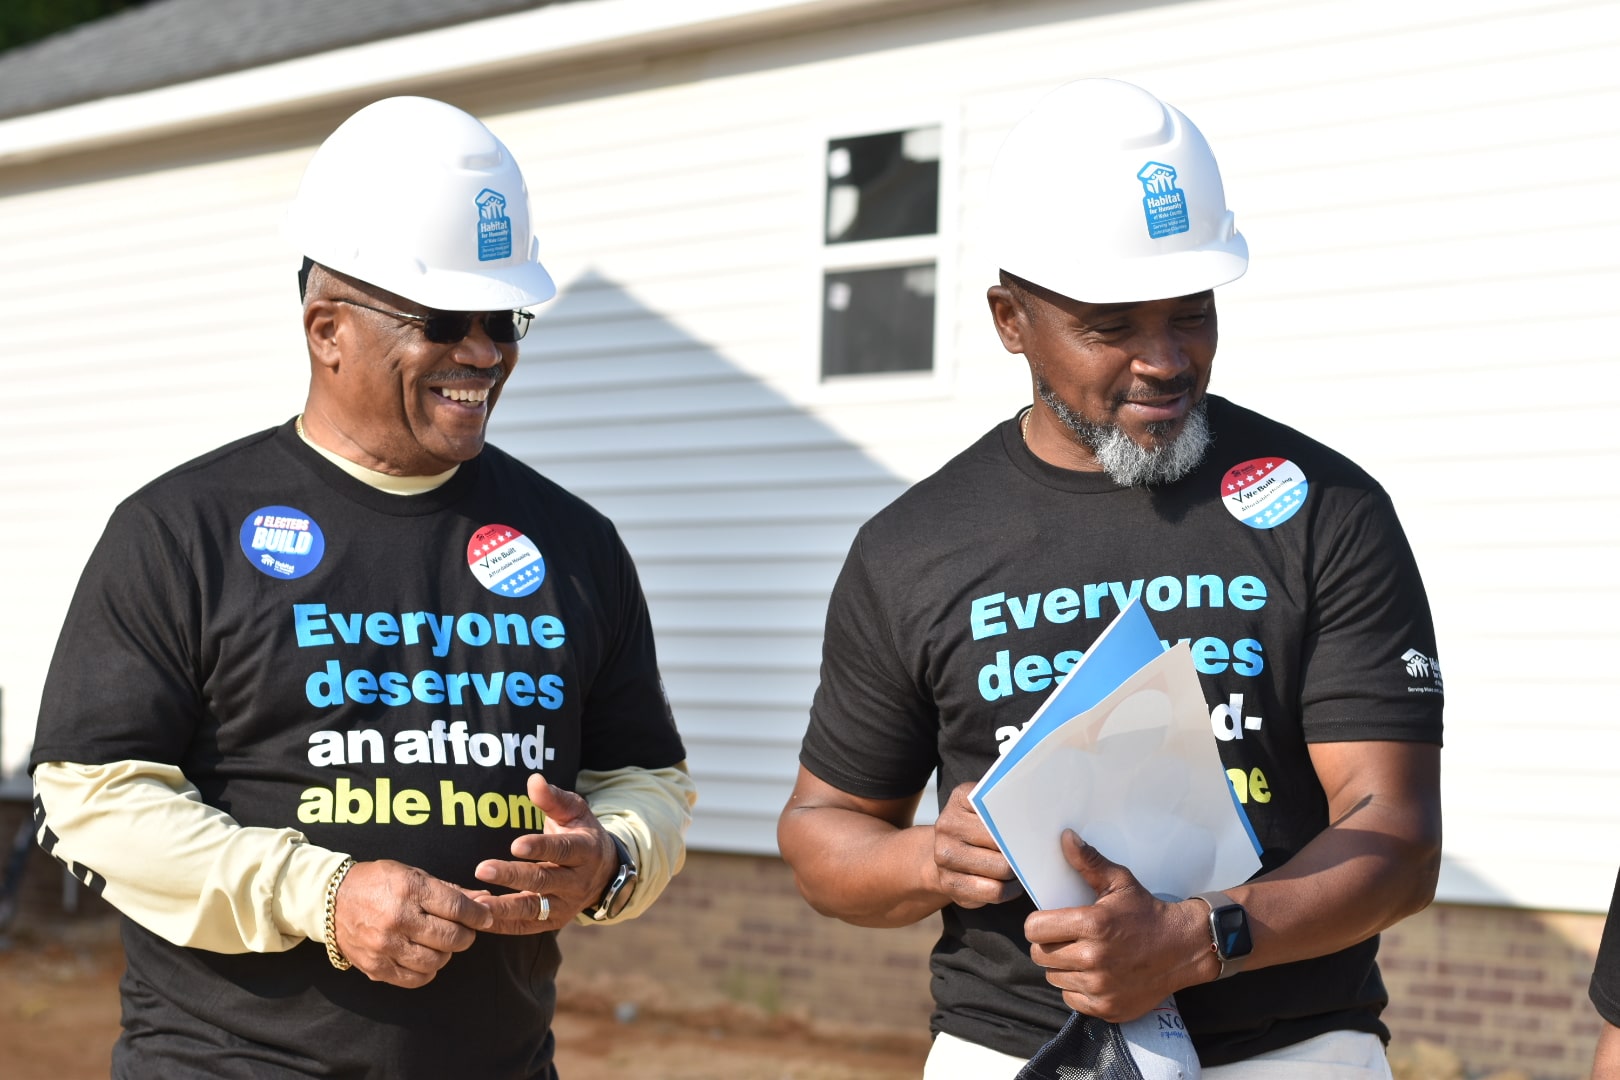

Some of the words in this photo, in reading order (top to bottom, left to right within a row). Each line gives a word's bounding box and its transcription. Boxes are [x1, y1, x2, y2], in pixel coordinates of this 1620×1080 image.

[1147, 193, 1181, 208] Habitat
[481, 220, 508, 232] Habitat
[1244, 490, 1258, 500] We
[1257, 477, 1276, 492] Built
[251, 527, 314, 556] BUILD
[490, 556, 503, 565] We
[500, 547, 516, 560] Built
[970, 574, 1268, 641] Everyone
[292, 603, 566, 657] Everyone
[305, 659, 564, 710] deserves
[978, 636, 1264, 702] deses
[307, 728, 385, 768] an
[393, 719, 556, 771] afford-
[995, 721, 1030, 756] a
[297, 777, 431, 826] able
[440, 780, 545, 831] hom
